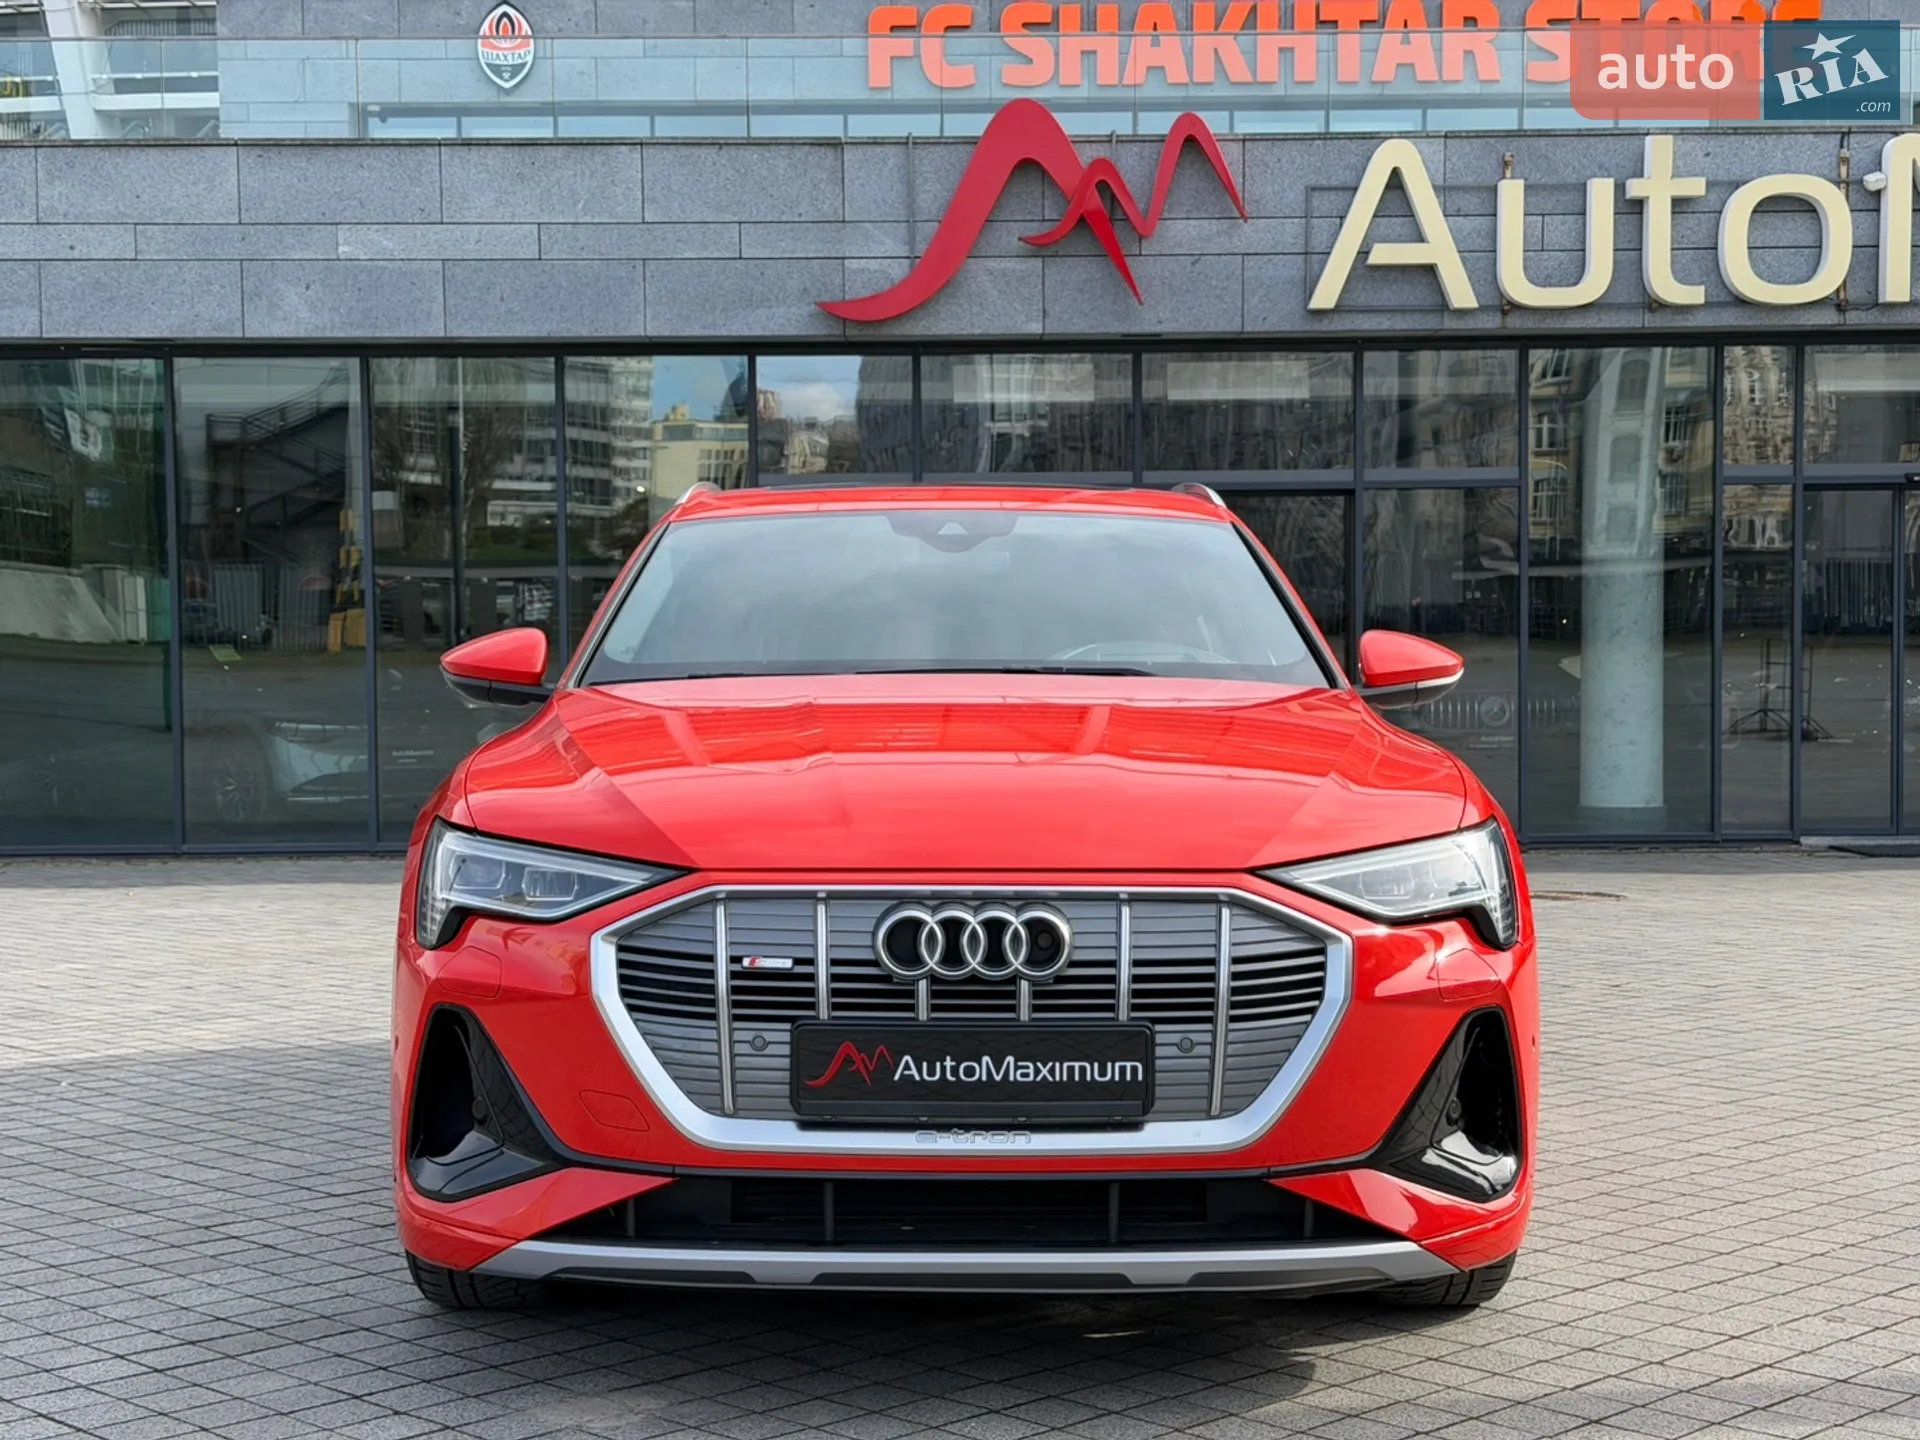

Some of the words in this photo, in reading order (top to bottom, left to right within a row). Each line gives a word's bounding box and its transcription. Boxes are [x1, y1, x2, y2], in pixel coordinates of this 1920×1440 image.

[481, 49, 532, 62] ШАХТАР
[868, 3, 976, 89] FC
[1000, 0, 1501, 87] SHAKHTAR
[1307, 134, 1920, 310] Auto
[893, 1054, 1144, 1082] AutoMaximum
[915, 1128, 1032, 1144] e-tron
